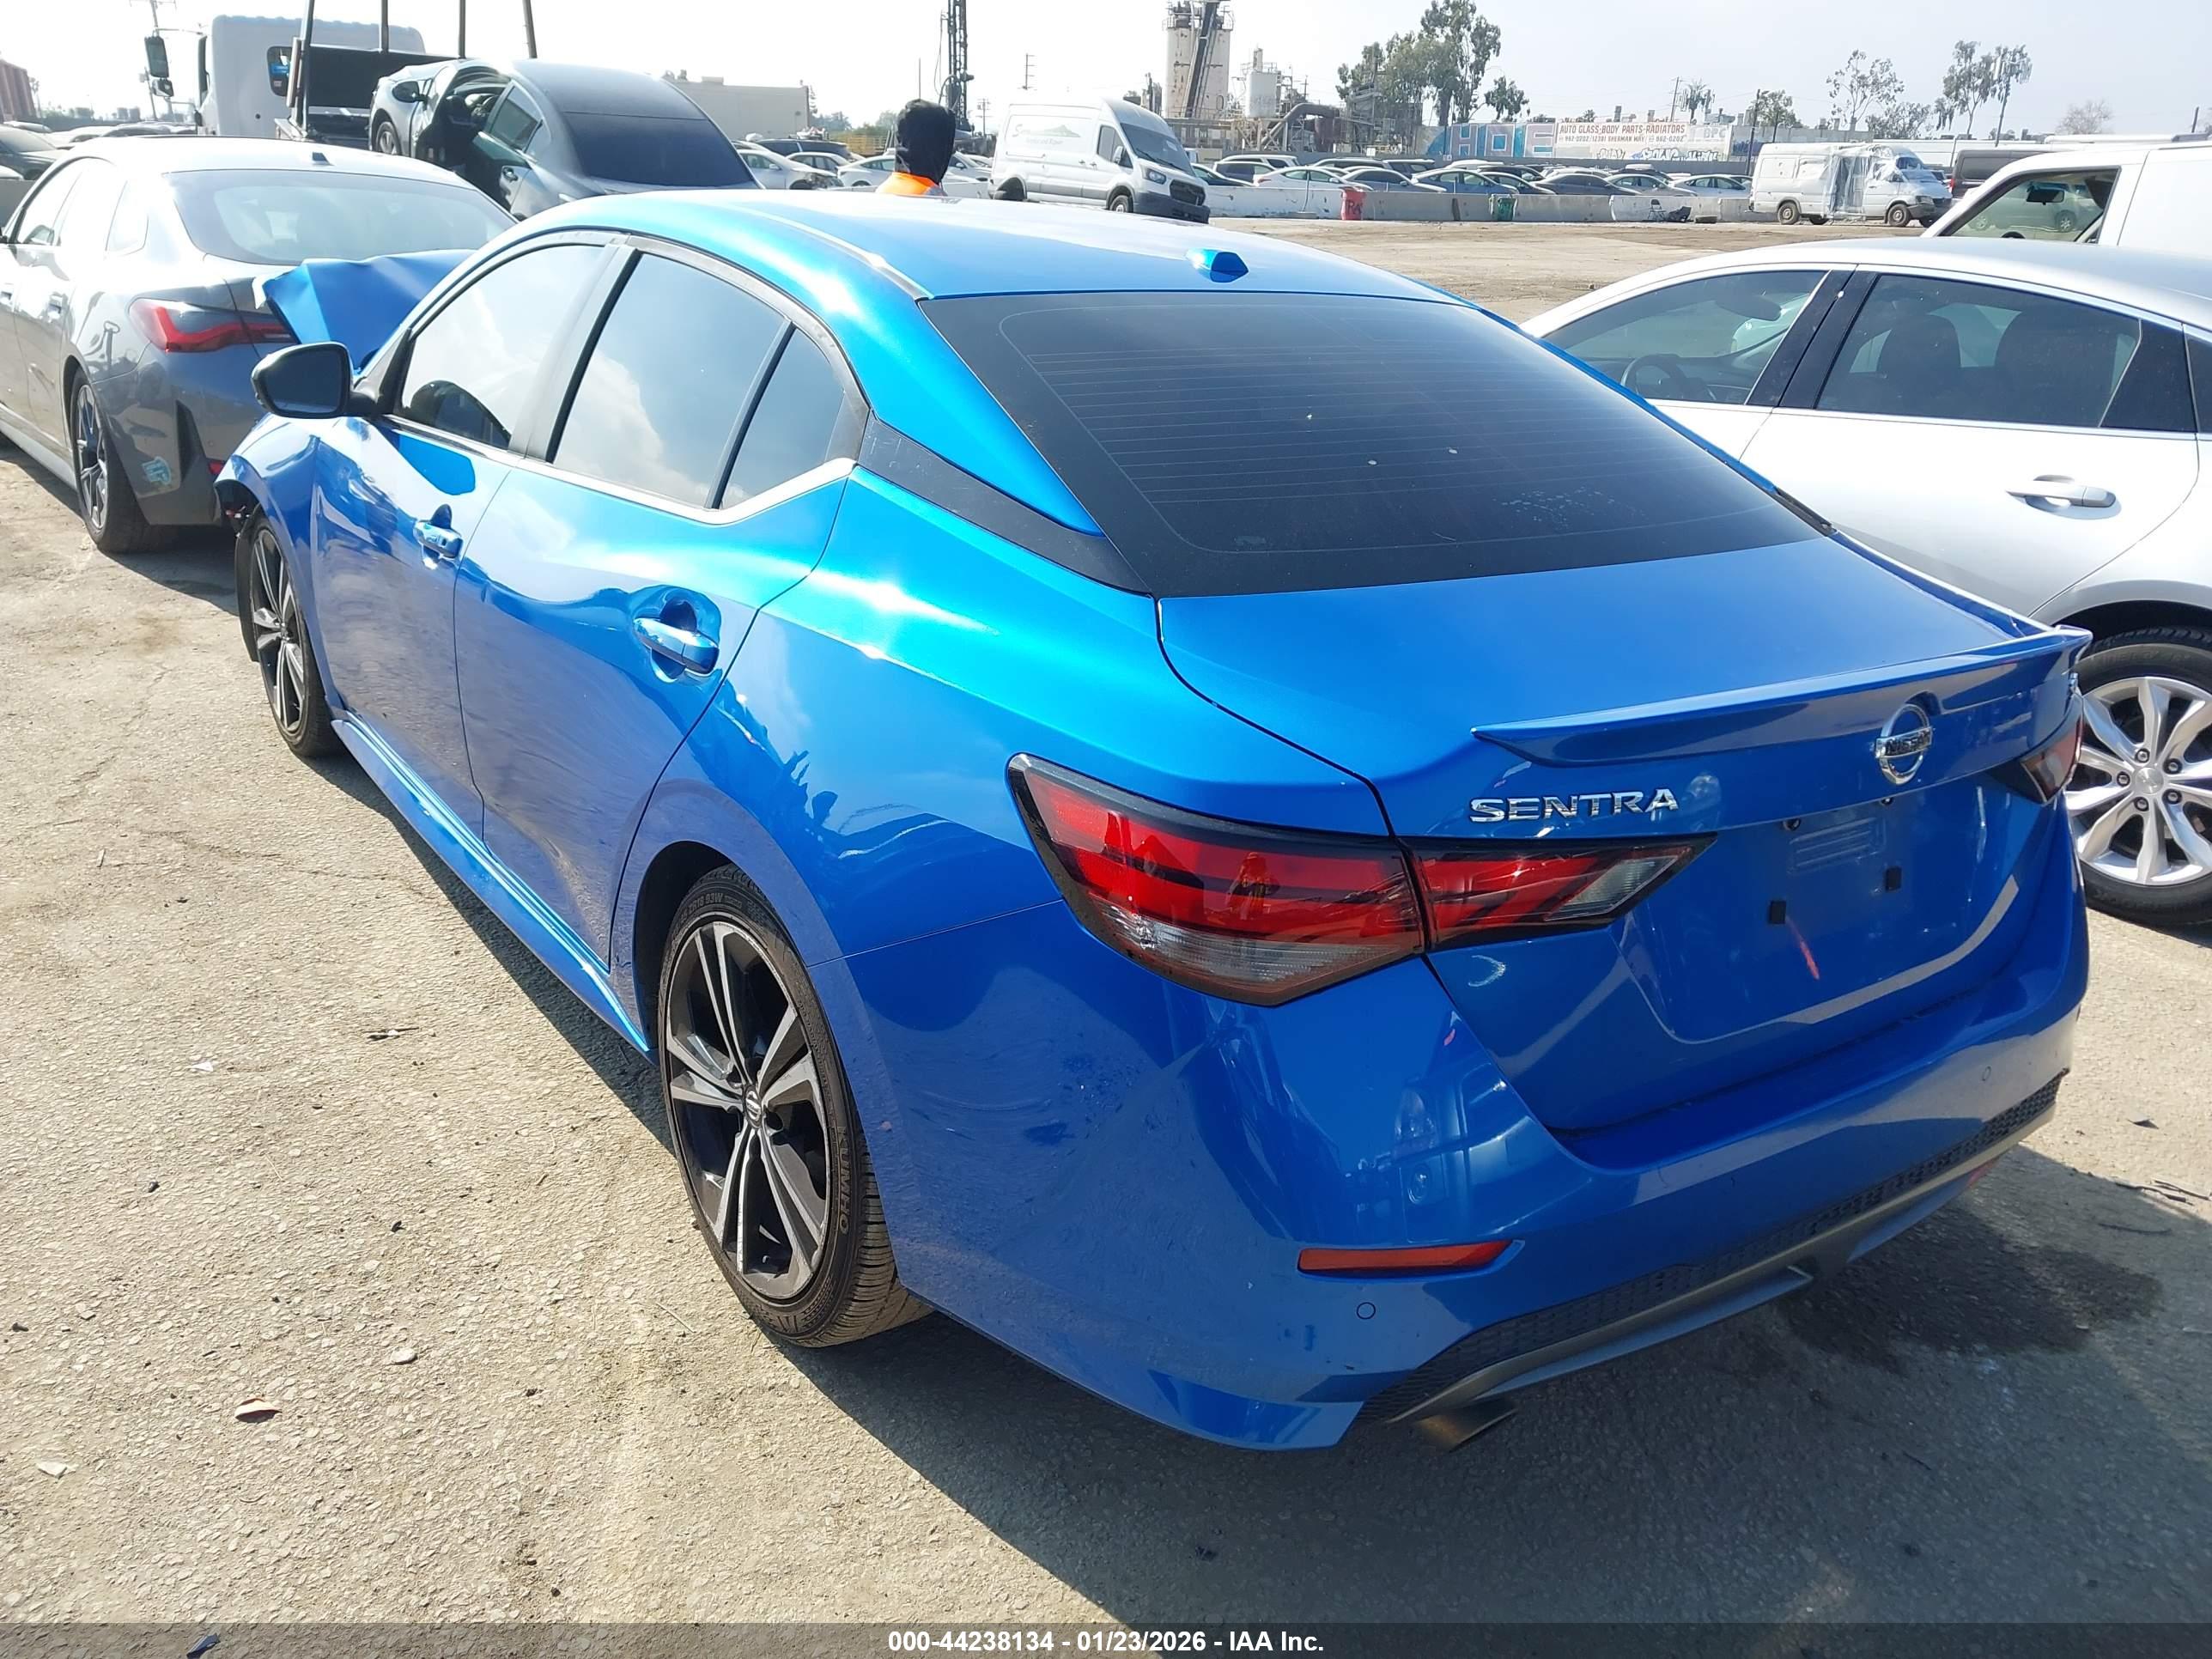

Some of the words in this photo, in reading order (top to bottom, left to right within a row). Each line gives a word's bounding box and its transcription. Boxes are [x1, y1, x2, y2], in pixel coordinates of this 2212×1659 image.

[1559, 125, 1577, 134] AUTO
[1469, 788, 1679, 822] SENTRA
[837, 1126, 851, 1235] KUMHO
